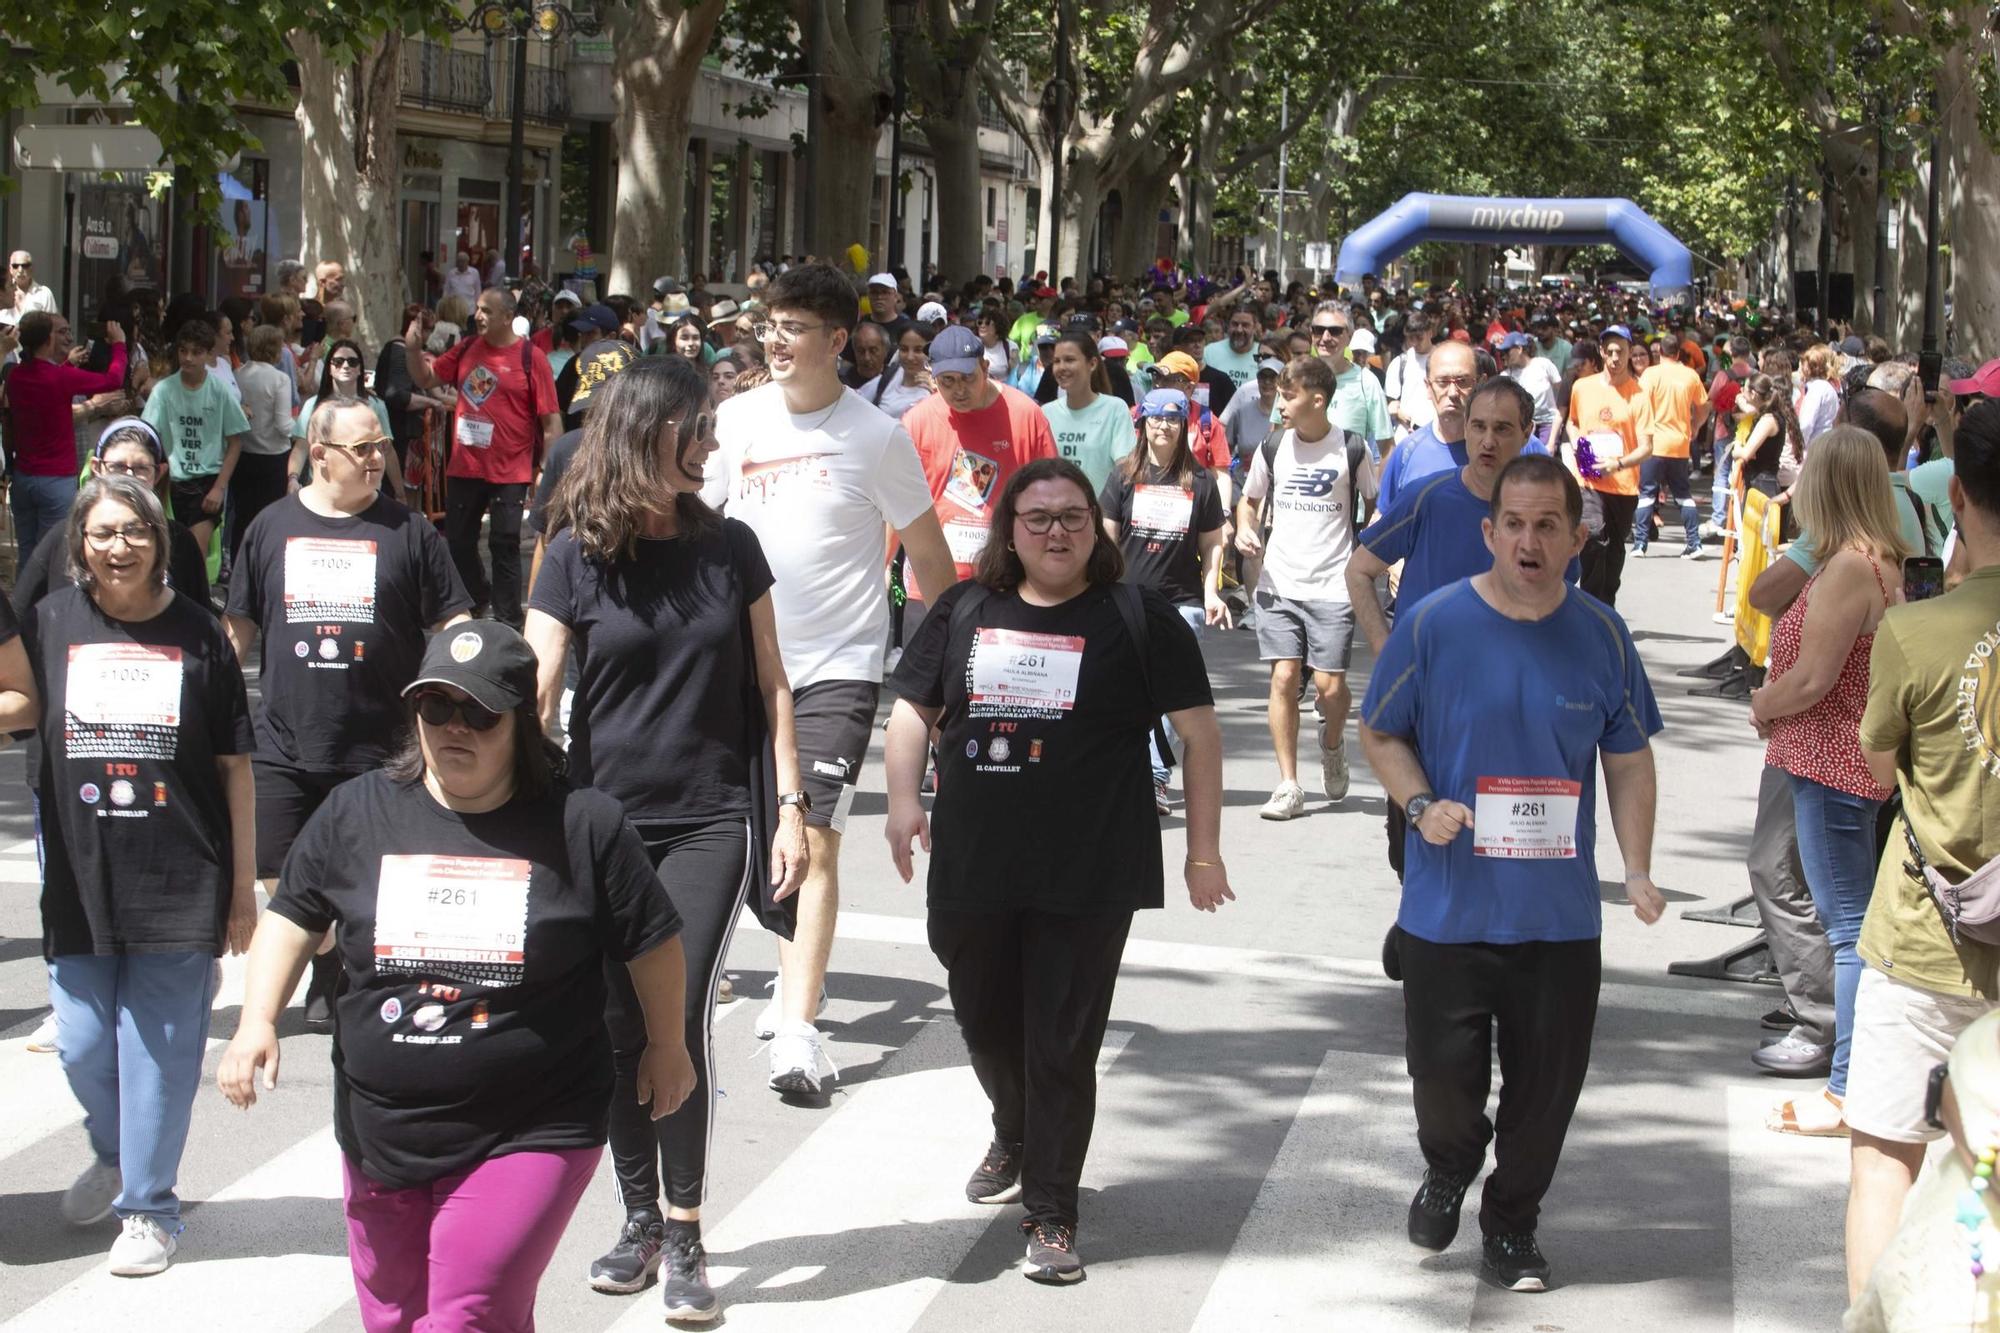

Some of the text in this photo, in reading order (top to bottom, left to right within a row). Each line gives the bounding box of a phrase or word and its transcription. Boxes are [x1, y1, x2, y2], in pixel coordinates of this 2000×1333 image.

[1471, 203, 1564, 234] mychip
[179, 416, 203, 426] SOM
[185, 428, 197, 438] DI
[1058, 432, 1086, 443] SOM
[181, 439, 202, 450] VER
[185, 451, 196, 461] SI
[1063, 445, 1077, 457] DI
[1295, 499, 1343, 513] balance
[1009, 654, 1046, 668] #261
[983, 695, 1002, 703] SOM
[1004, 695, 1064, 708] DIVERSITAT
[989, 722, 1018, 732] I TU
[105, 763, 138, 776] I TU
[984, 765, 1021, 773] CASTELLET
[1512, 803, 1547, 817] #261
[1485, 847, 1567, 857] SOM DIVERSITAT
[428, 888, 478, 906] #261
[431, 984, 462, 1001] TU
[392, 1034, 404, 1043] EL
